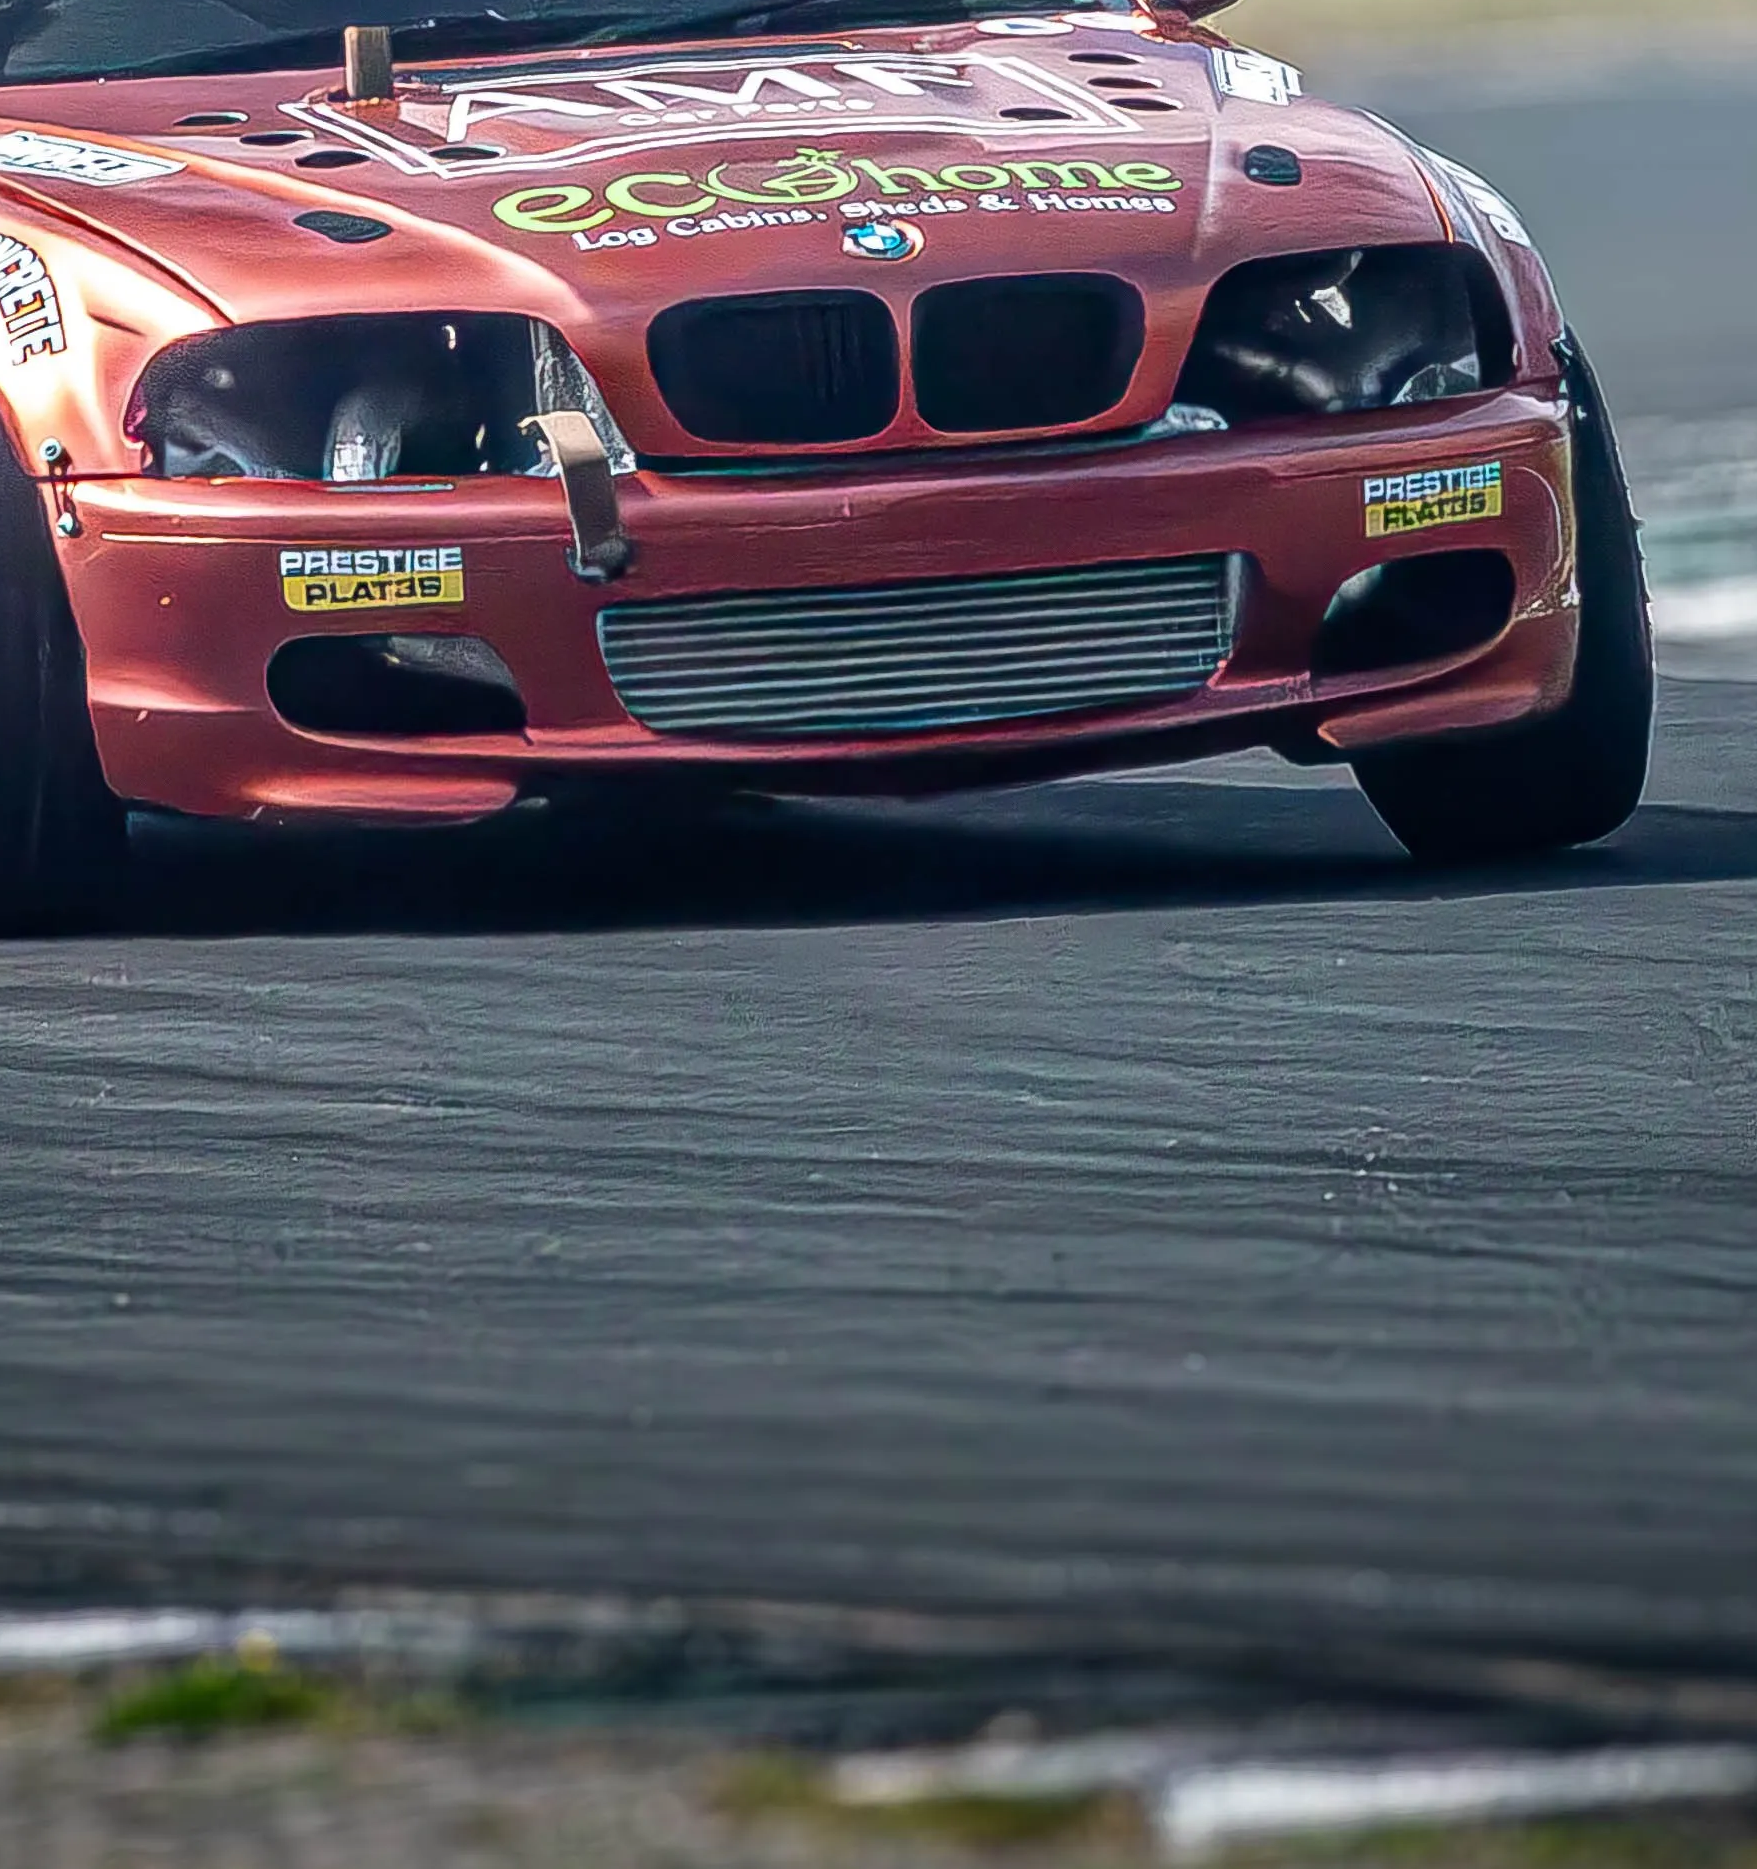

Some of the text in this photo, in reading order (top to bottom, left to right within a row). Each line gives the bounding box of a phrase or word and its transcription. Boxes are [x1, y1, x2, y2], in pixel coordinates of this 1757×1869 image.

[571, 226, 659, 252] Log
[838, 195, 970, 220] Sheds
[978, 193, 1019, 212] &
[1027, 192, 1179, 213] Homes
[1364, 460, 1501, 505] PRESTIGE
[279, 546, 463, 576] PRESTIGE
